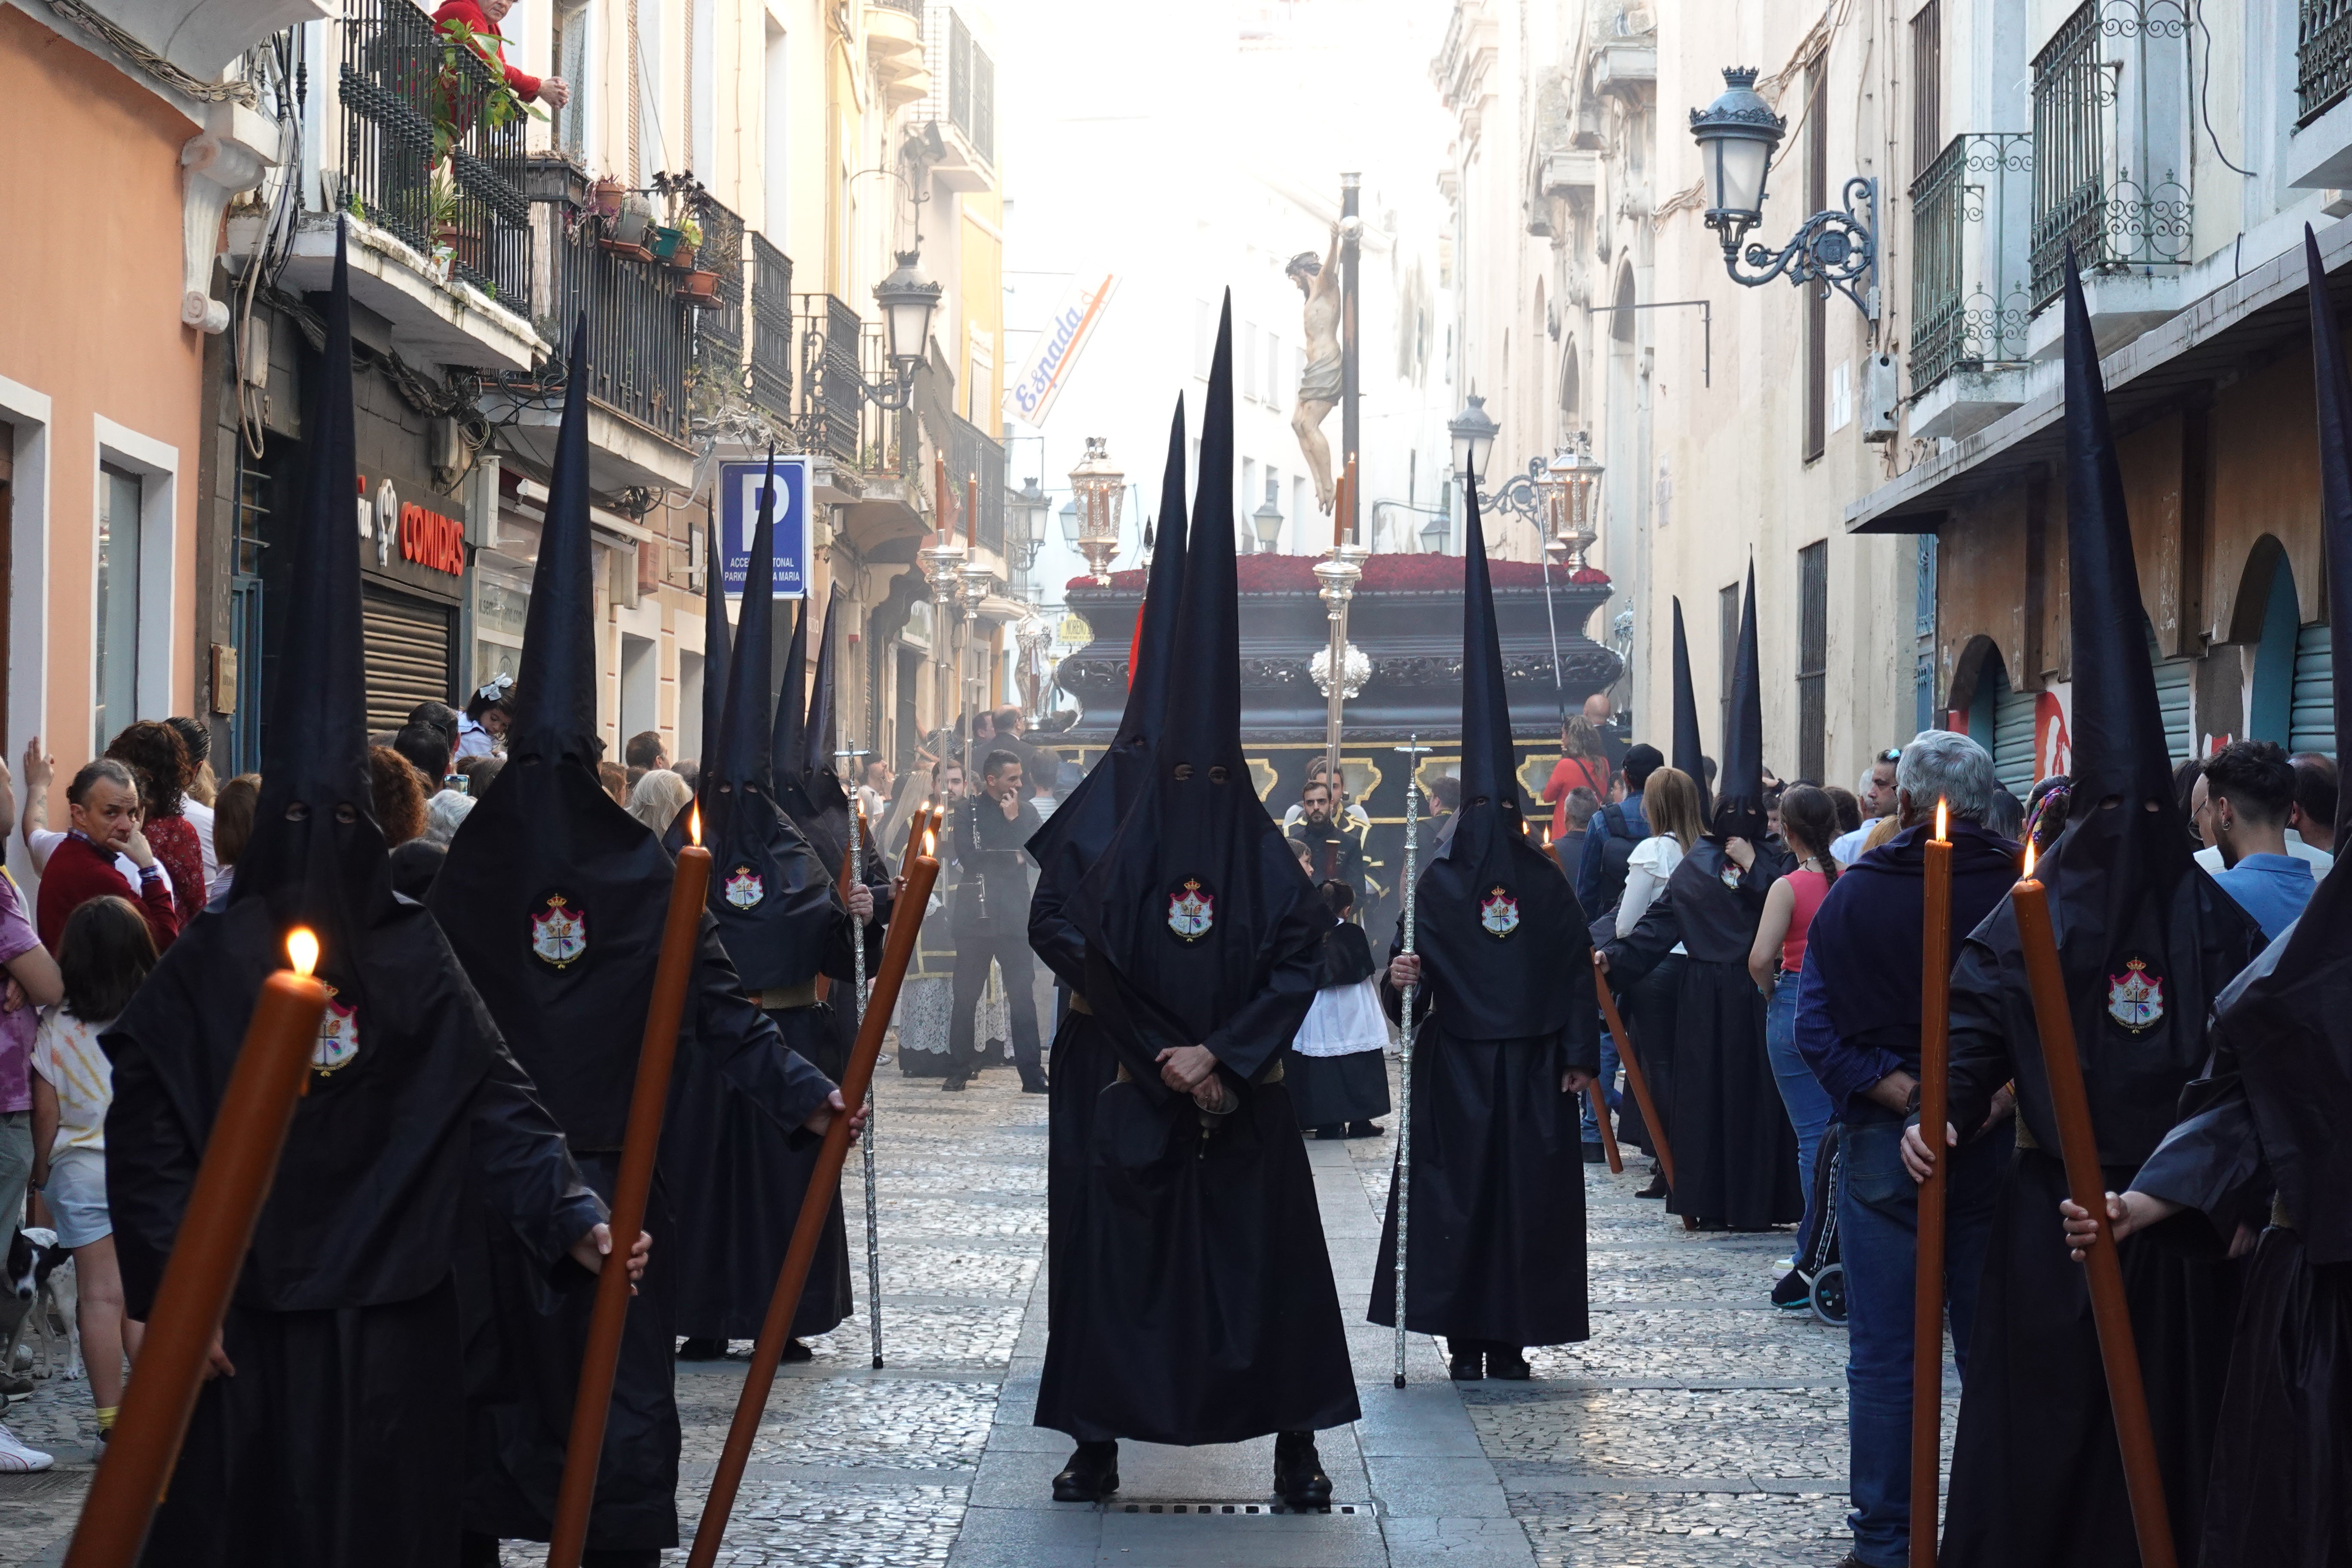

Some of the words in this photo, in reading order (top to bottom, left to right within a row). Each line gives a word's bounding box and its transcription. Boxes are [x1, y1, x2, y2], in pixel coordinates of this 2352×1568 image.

[1015, 306, 1084, 413] Espada
[399, 501, 464, 577] COMIDAS
[742, 474, 790, 551] P
[779, 571, 800, 582] MARIA
[1066, 620, 1086, 635] MORENO
